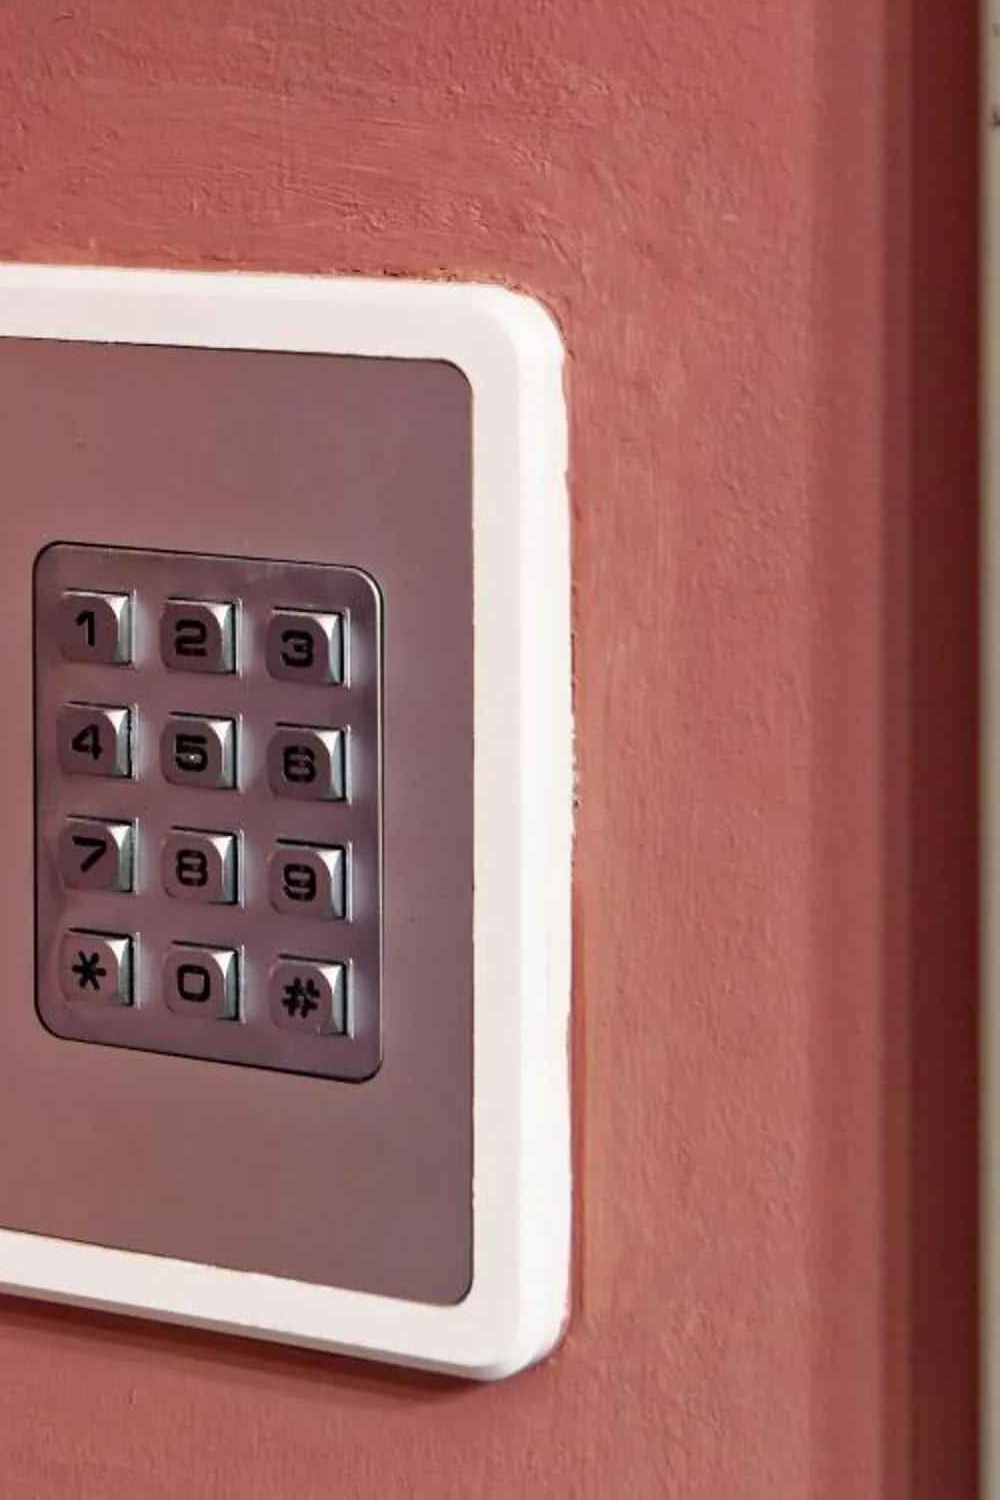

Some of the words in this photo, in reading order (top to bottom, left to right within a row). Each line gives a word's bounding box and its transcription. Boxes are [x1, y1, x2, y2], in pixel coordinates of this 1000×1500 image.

[75, 611, 96, 647] 1
[174, 619, 208, 657] 2
[281, 630, 315, 668] 3
[71, 723, 103, 761] 4
[175, 734, 208, 772] 5
[283, 745, 316, 783] 6
[72, 835, 107, 873] 7
[175, 850, 208, 887] 8
[283, 863, 317, 900] 9
[281, 976, 321, 1019] #
